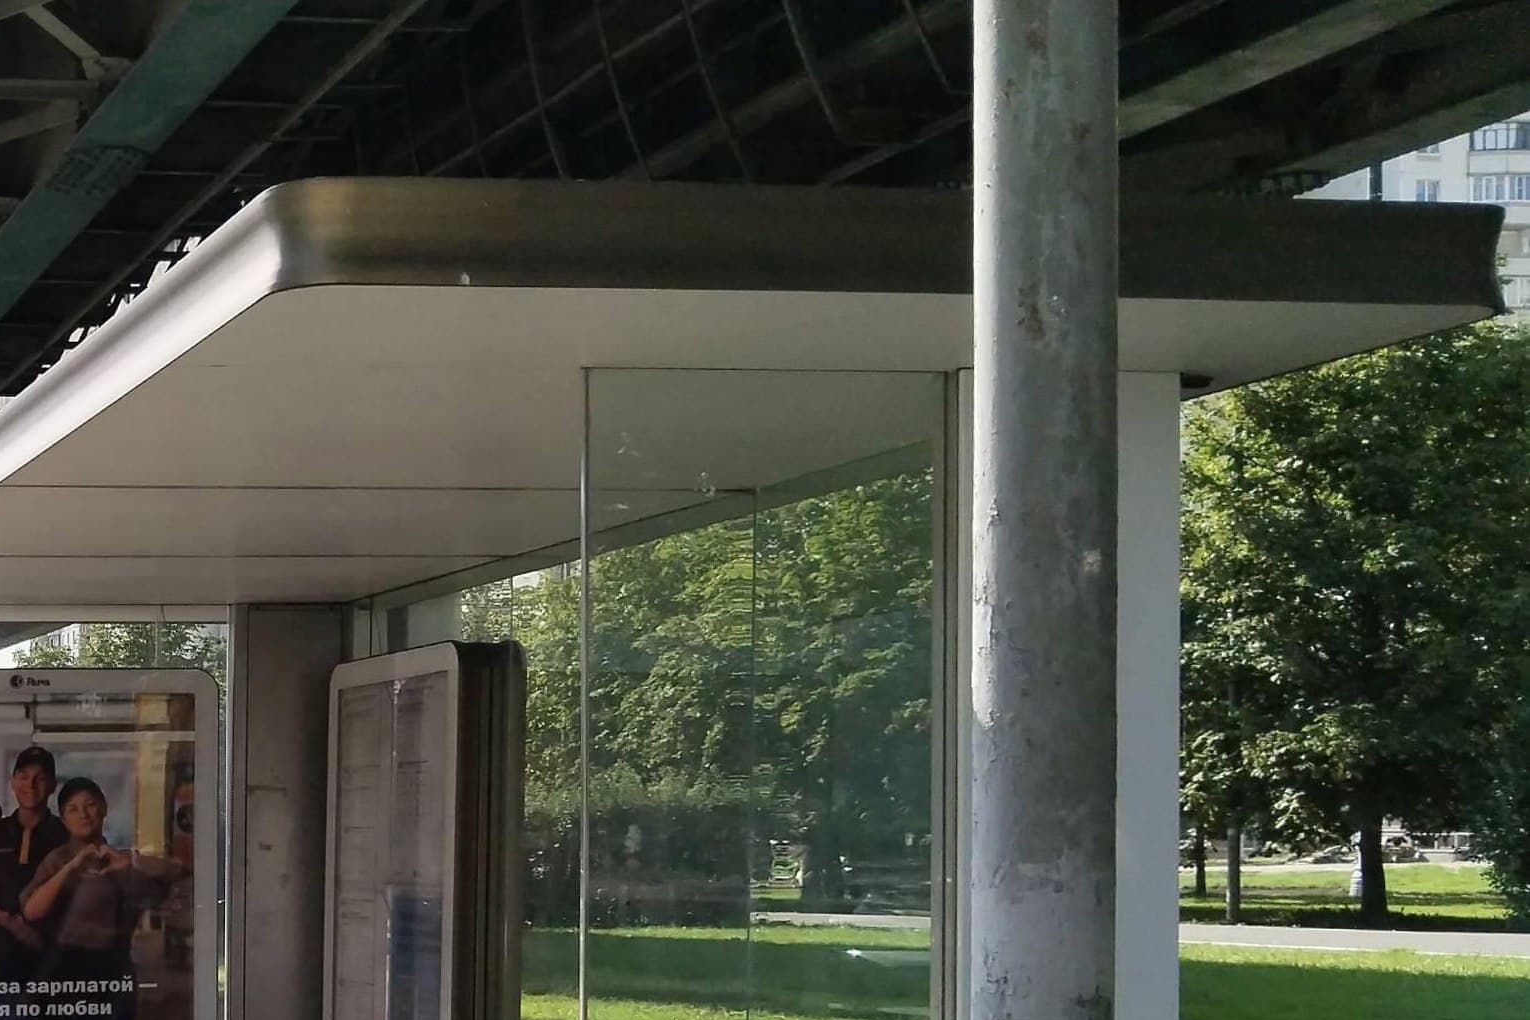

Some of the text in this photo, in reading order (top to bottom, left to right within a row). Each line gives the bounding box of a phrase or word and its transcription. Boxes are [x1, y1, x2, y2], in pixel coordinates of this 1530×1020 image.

[26, 976, 134, 996] зарплатой
[16, 1005, 40, 1016] по
[45, 1001, 112, 1016] любви
